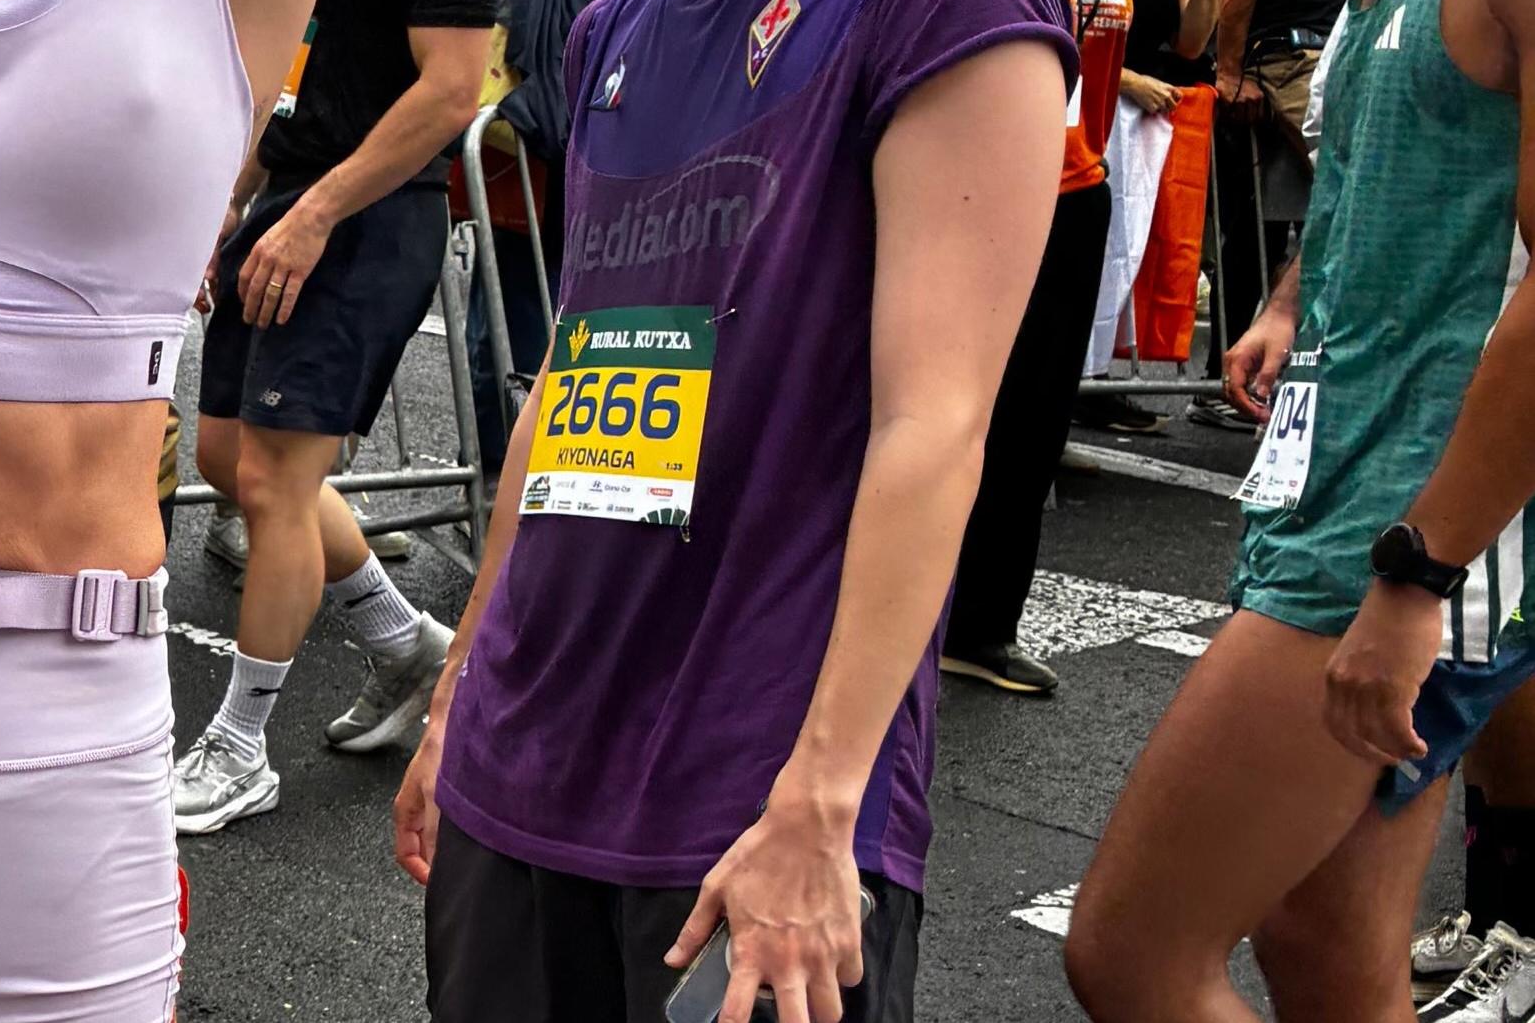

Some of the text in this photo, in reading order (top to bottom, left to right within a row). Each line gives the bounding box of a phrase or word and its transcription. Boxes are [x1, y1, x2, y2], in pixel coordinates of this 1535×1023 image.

[590, 331, 692, 350] RURAL KUTXA
[546, 372, 682, 440] 2666
[556, 447, 635, 469] KIYONAGA
